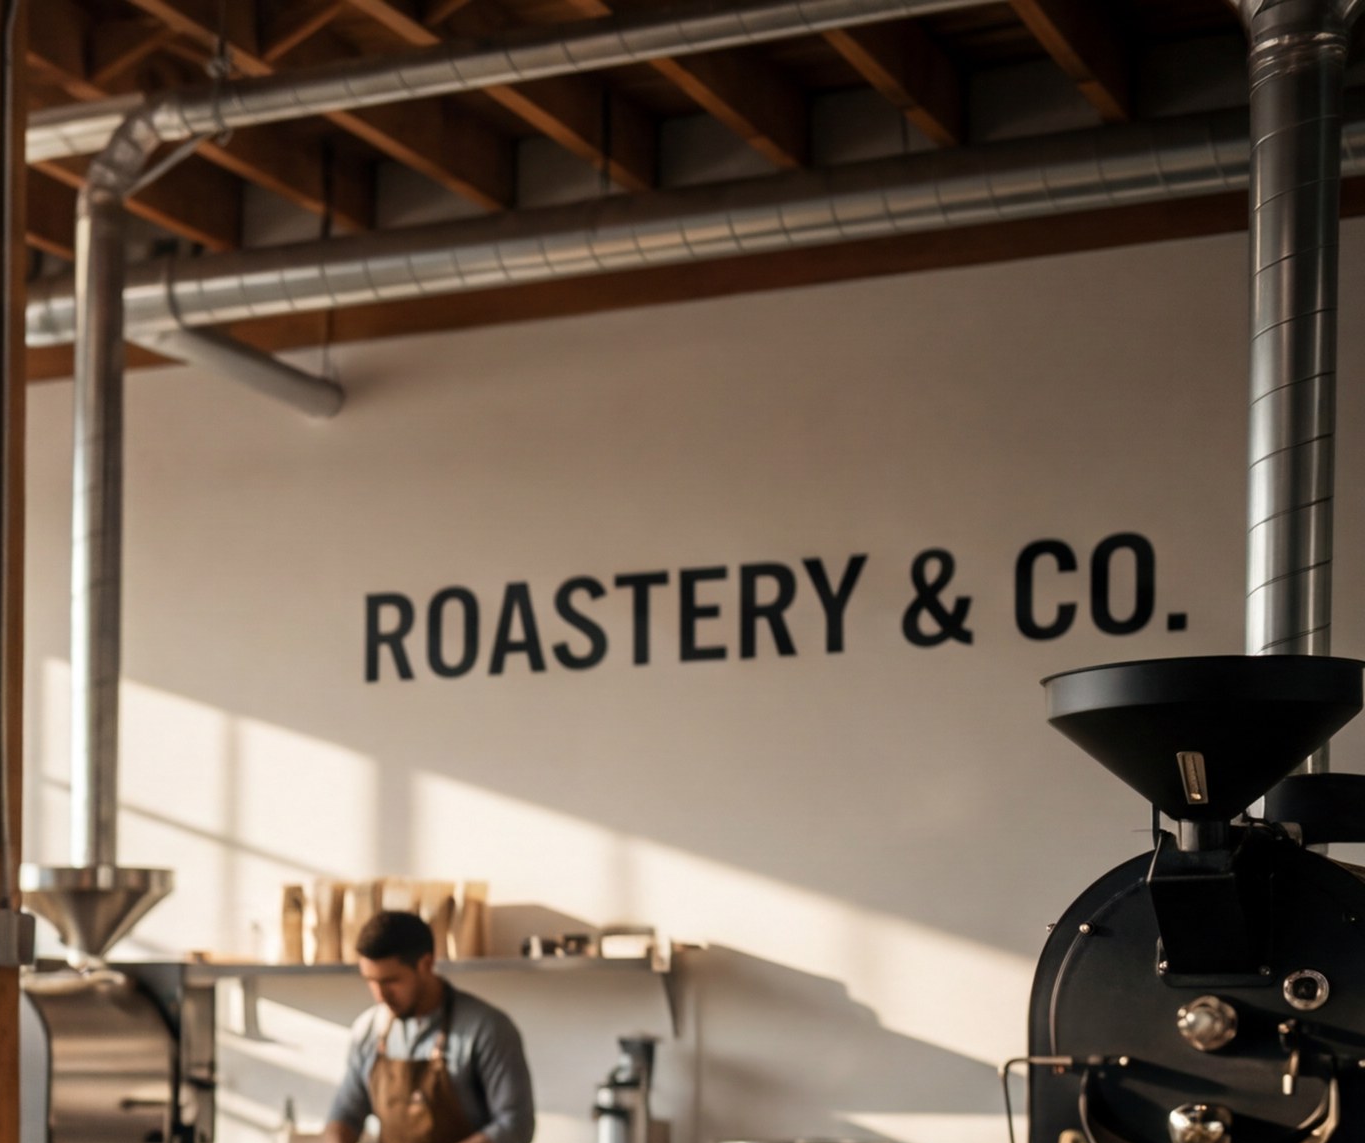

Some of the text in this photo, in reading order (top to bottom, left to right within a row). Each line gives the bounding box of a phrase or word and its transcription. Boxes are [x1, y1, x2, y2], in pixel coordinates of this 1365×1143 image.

[365, 529, 1190, 683] ROASTERY & CO.
